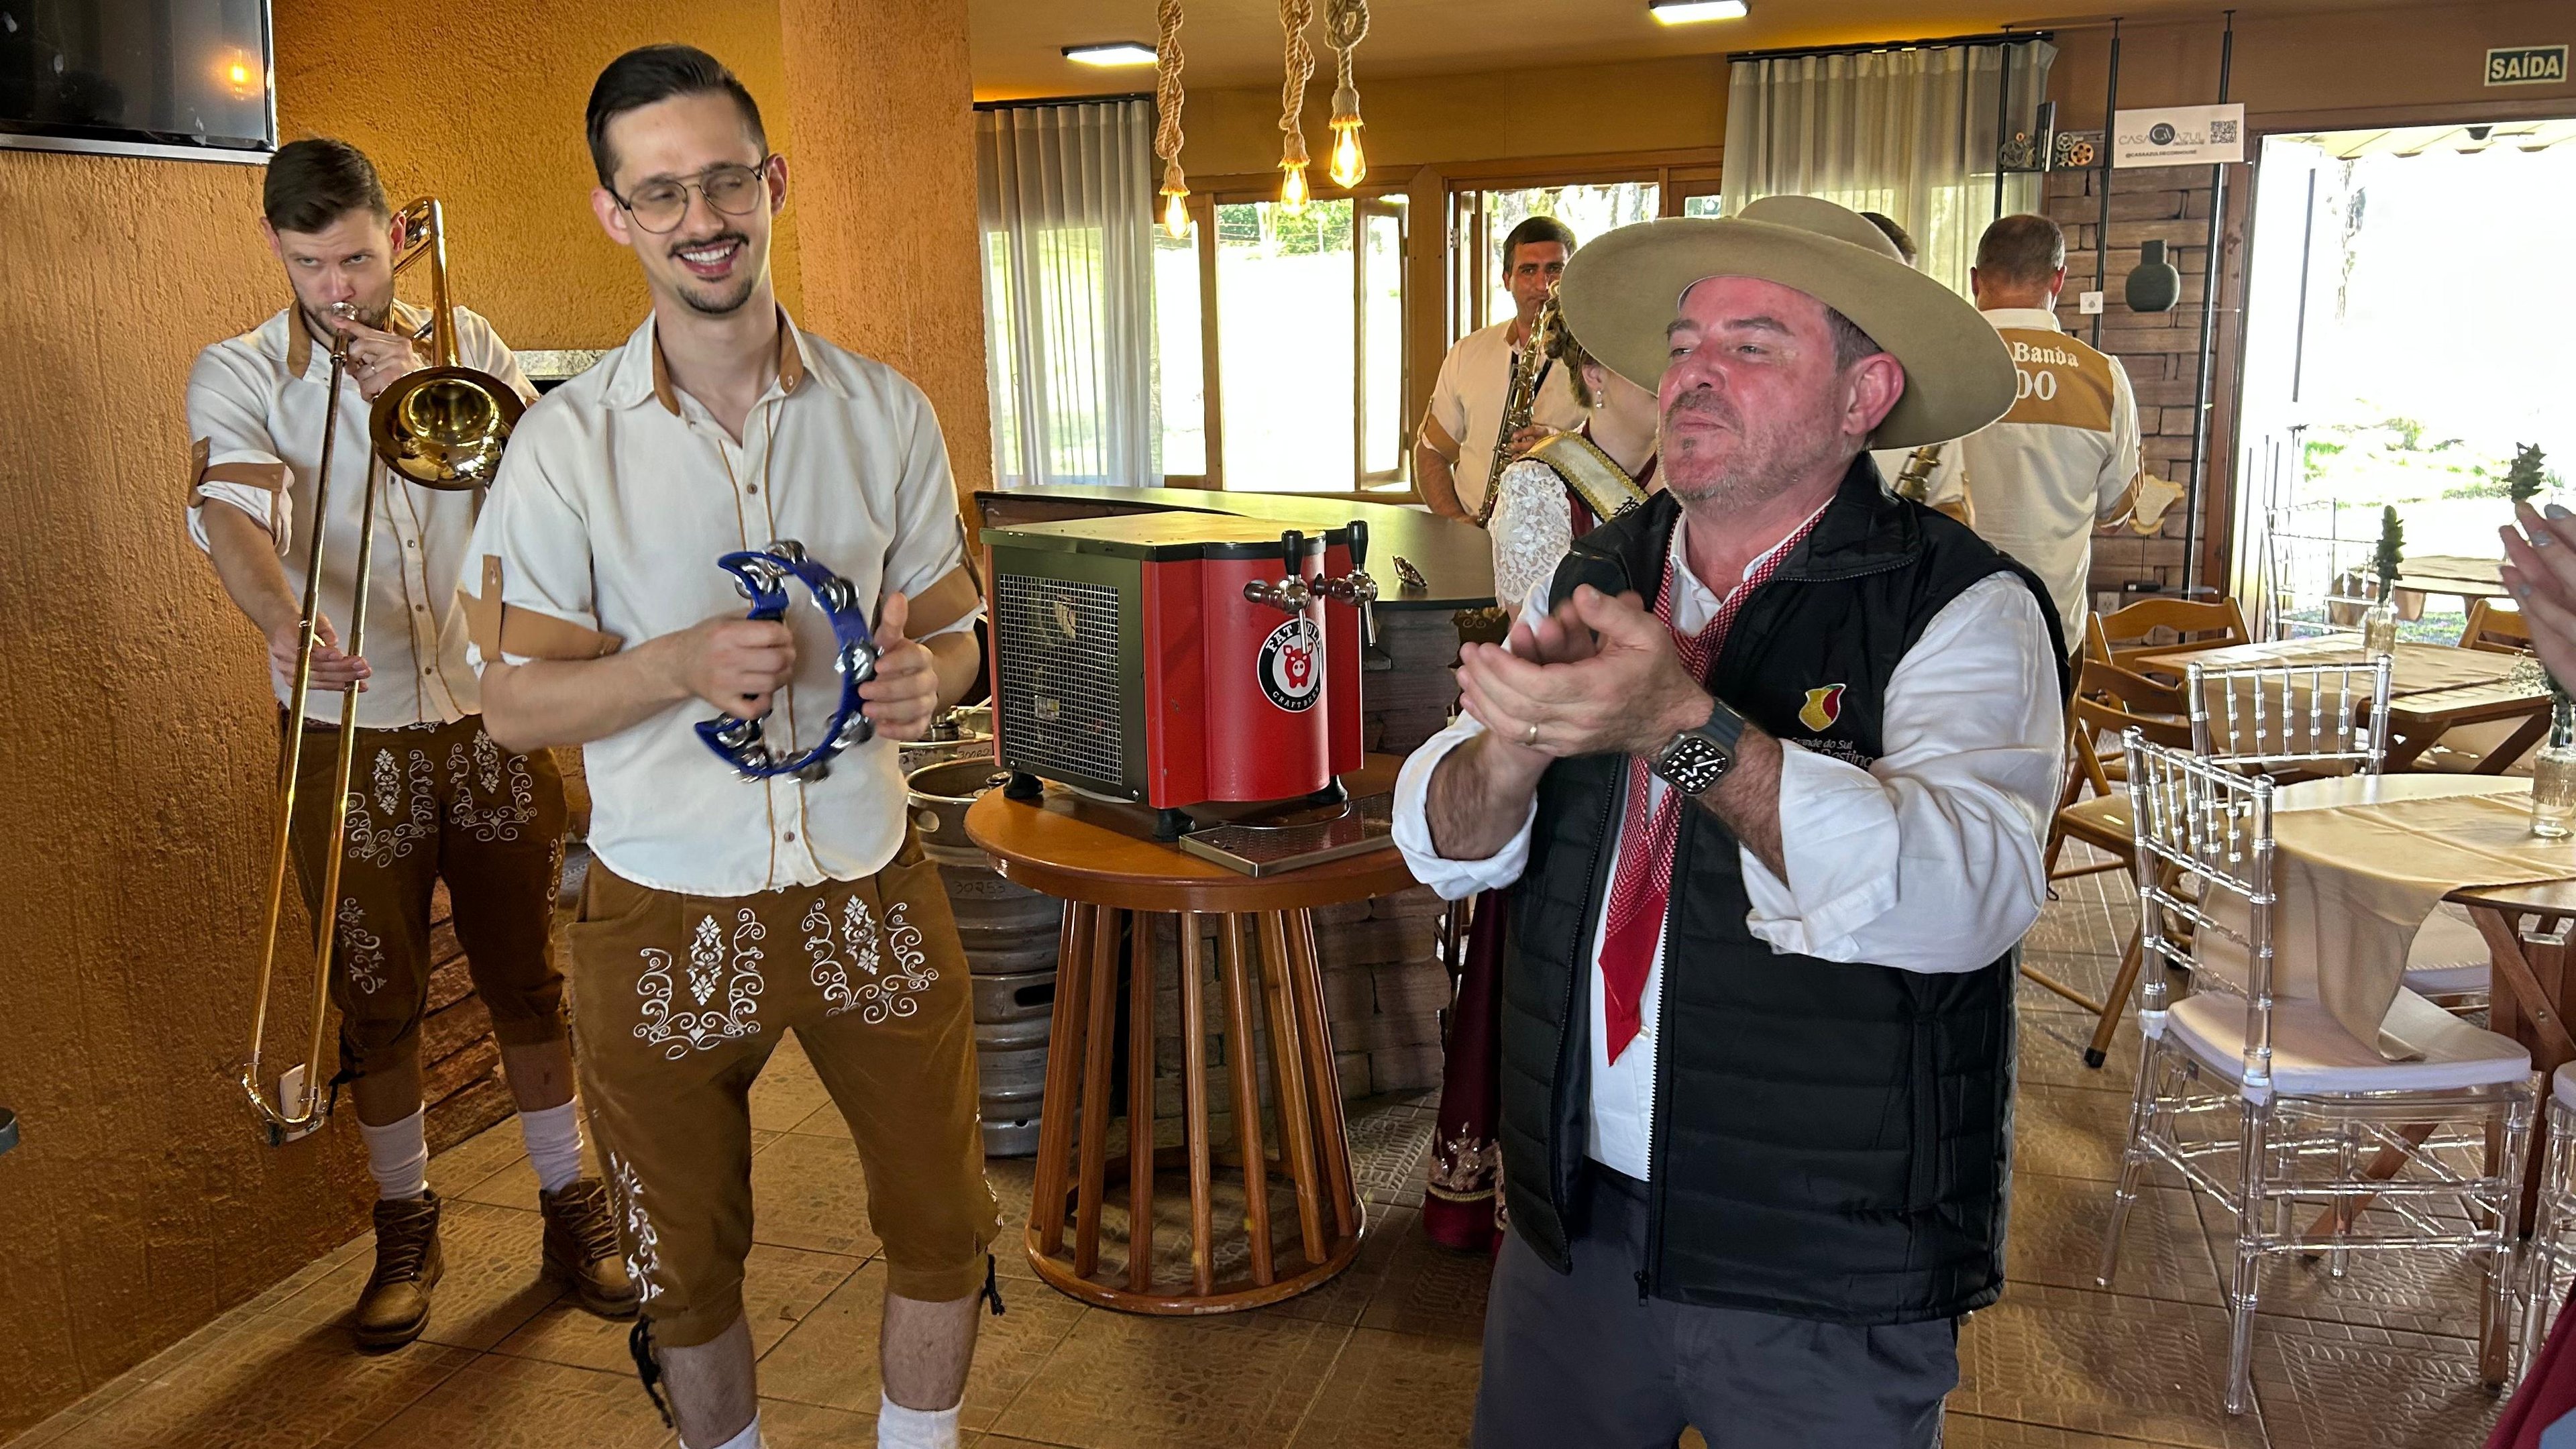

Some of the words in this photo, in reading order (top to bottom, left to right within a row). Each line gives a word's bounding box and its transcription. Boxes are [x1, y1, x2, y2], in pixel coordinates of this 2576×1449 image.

[2491, 52, 2560, 79] SAÍDA
[2118, 134, 2151, 145] CASA
[2174, 131, 2204, 143] AZUL
[2012, 341, 2079, 368] Banda
[1265, 625, 1293, 653] FAT
[1297, 623, 1320, 648] ULL
[1273, 691, 1301, 708] CRAFT
[1303, 686, 1320, 706] BEER
[1823, 739, 1836, 749] do
[1837, 740, 1854, 750] Sul
